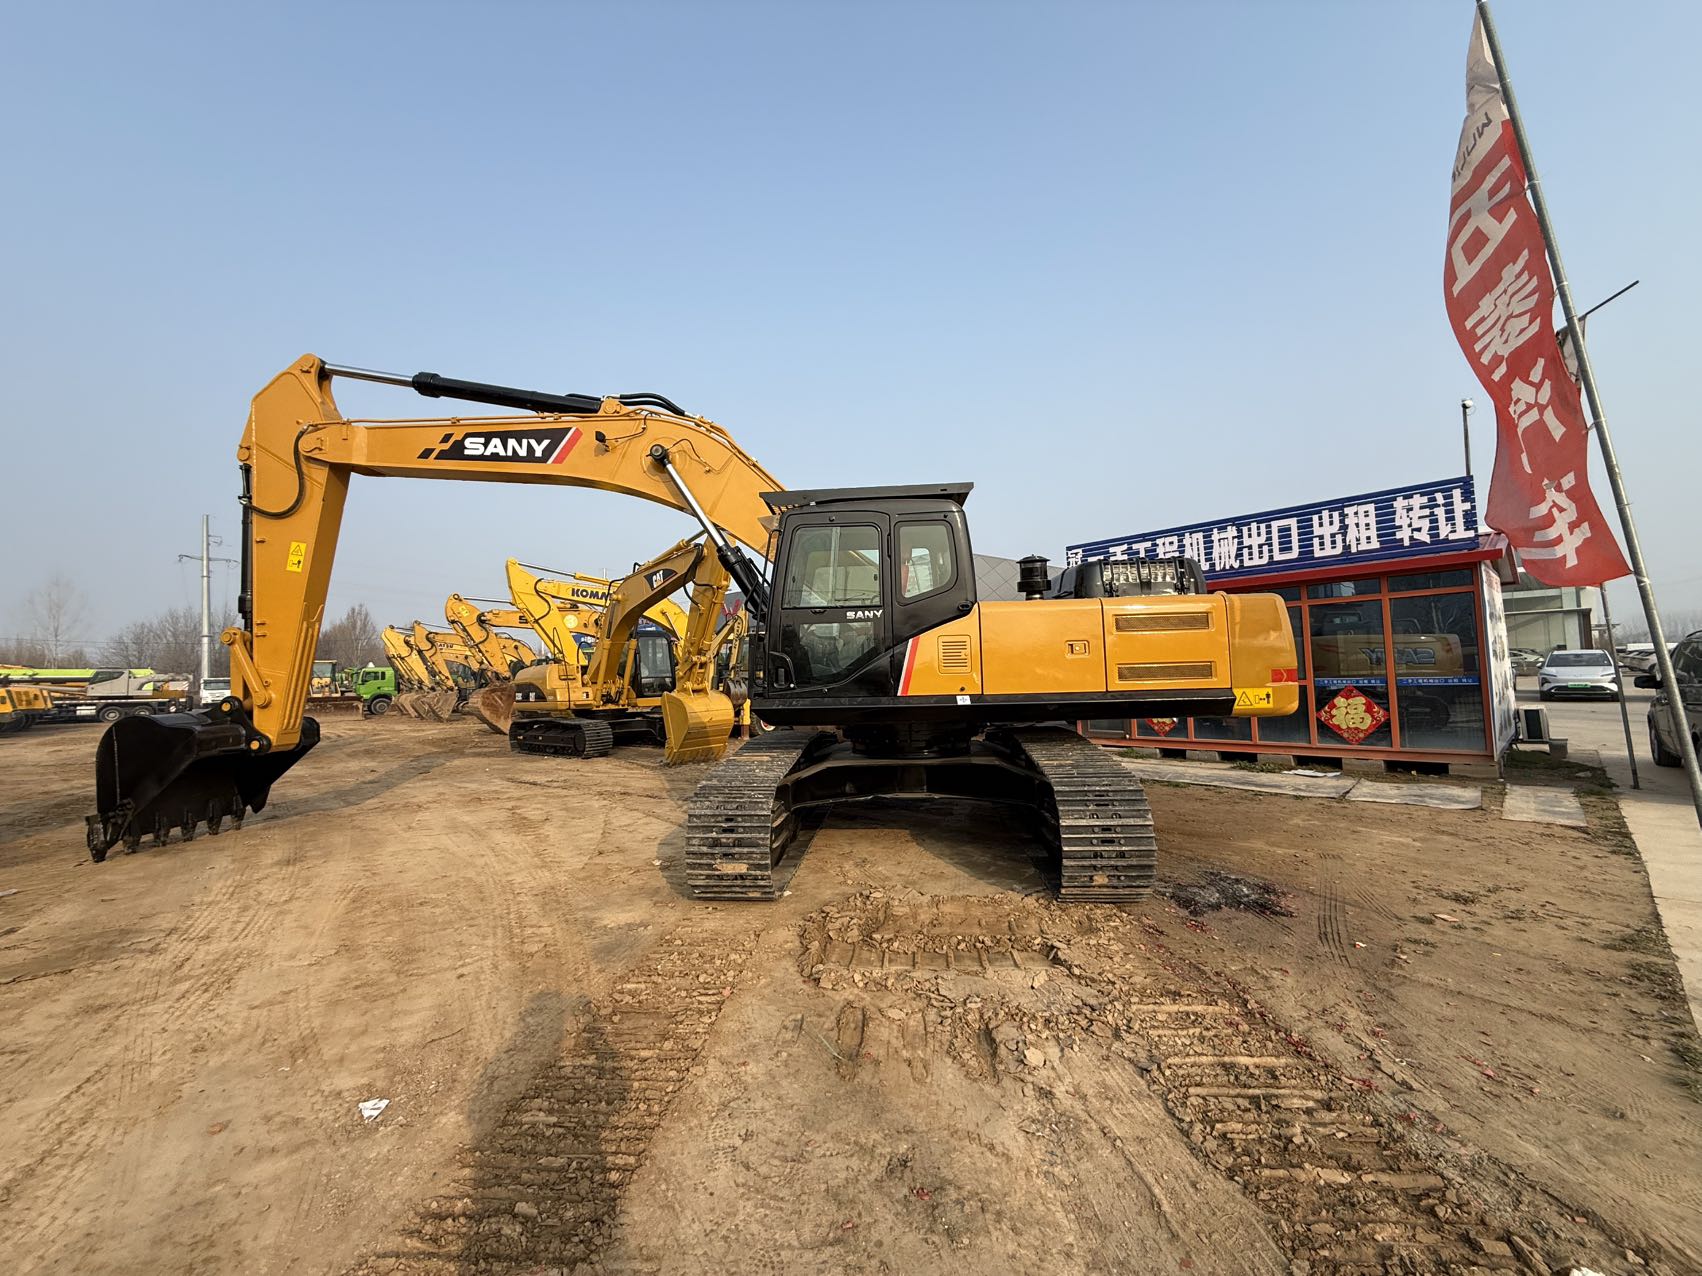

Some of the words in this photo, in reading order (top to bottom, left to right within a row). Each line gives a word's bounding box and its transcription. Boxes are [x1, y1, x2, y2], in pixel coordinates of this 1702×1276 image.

[463, 437, 551, 457] SANY
[1312, 503, 1381, 558] 出租
[1394, 488, 1476, 546] 转让
[652, 569, 664, 588] CAT
[571, 587, 609, 600] KOMA
[846, 610, 883, 619] SANY
[1330, 696, 1373, 730] 福
